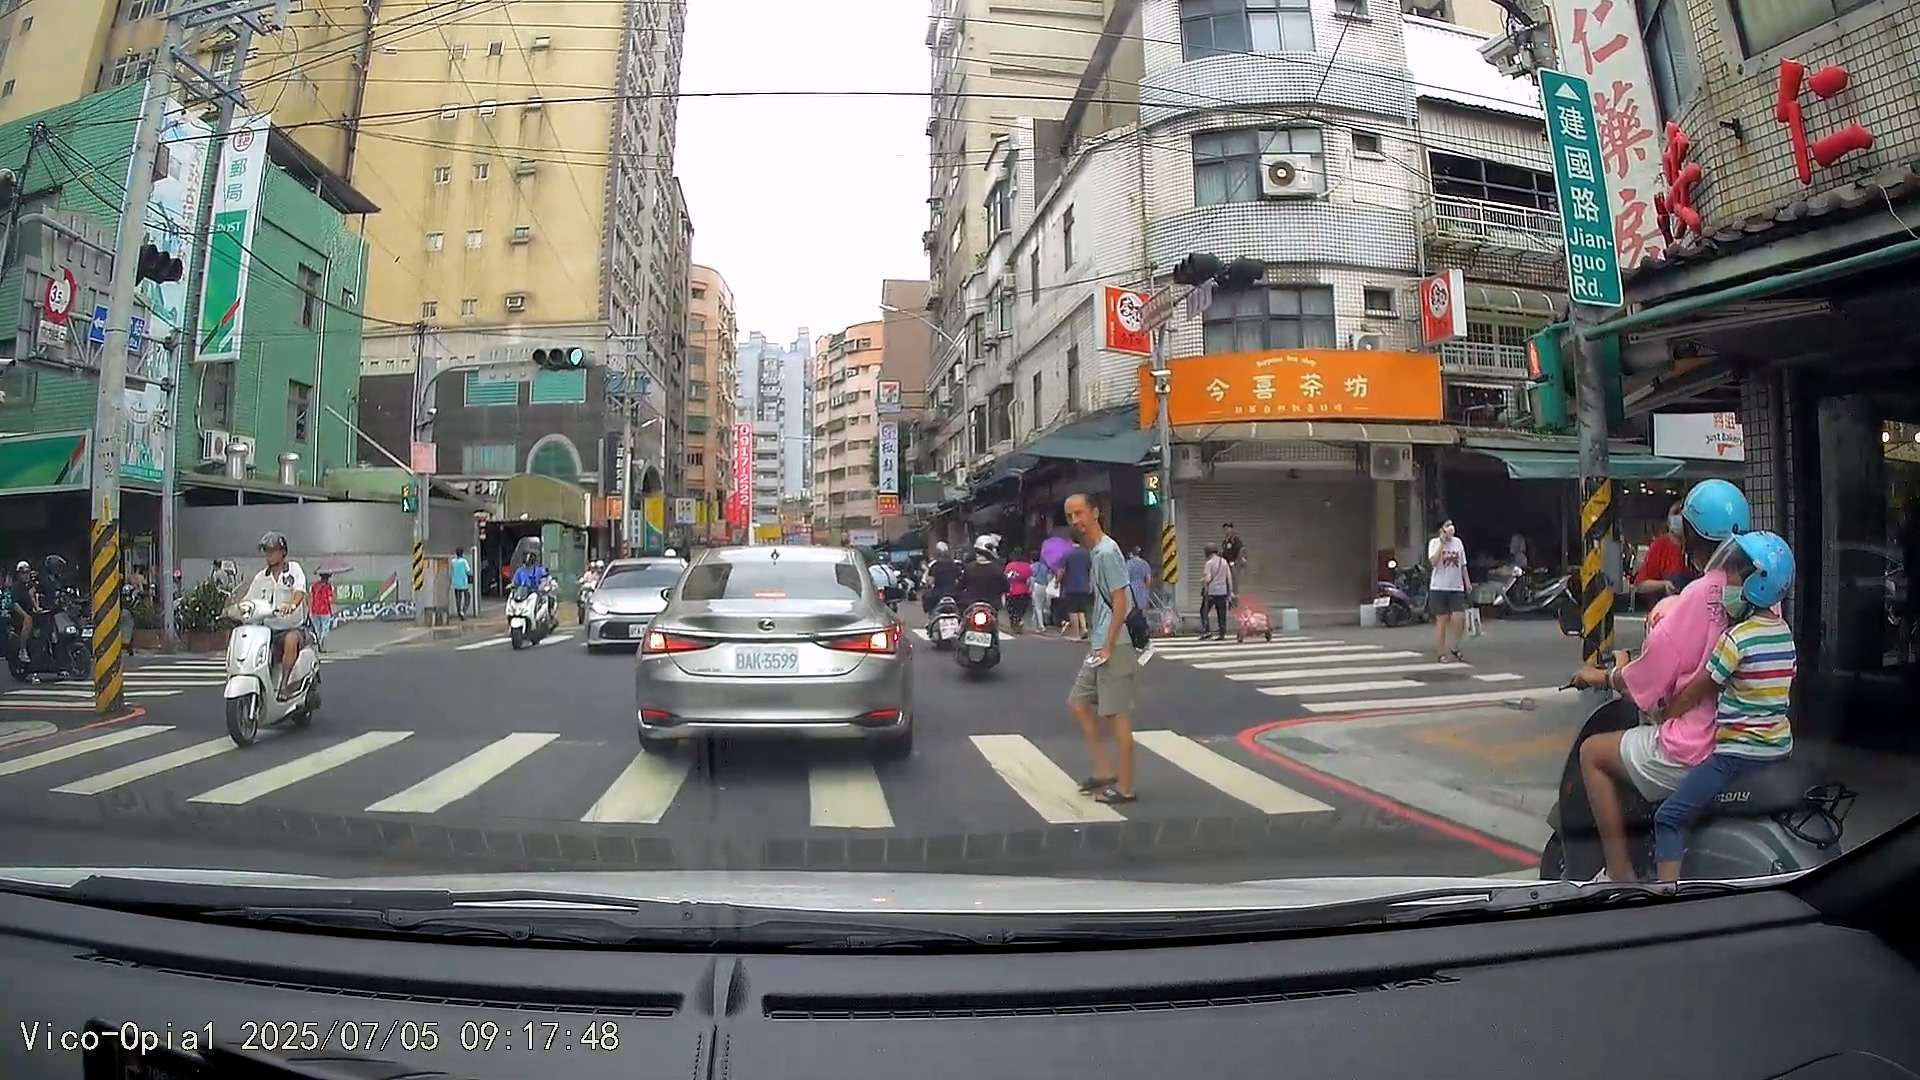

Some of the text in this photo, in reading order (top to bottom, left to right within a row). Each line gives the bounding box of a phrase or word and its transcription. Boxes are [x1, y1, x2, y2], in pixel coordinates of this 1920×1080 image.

[1557, 105, 1600, 225] 建國路
[226, 157, 248, 202] 郵局
[1569, 226, 1613, 250] Jian-
[1572, 253, 1607, 274] guo
[1573, 275, 1604, 298] Rd.
[1206, 373, 1368, 402] 今喜茶坊
[736, 653, 798, 670] BAK-3599
